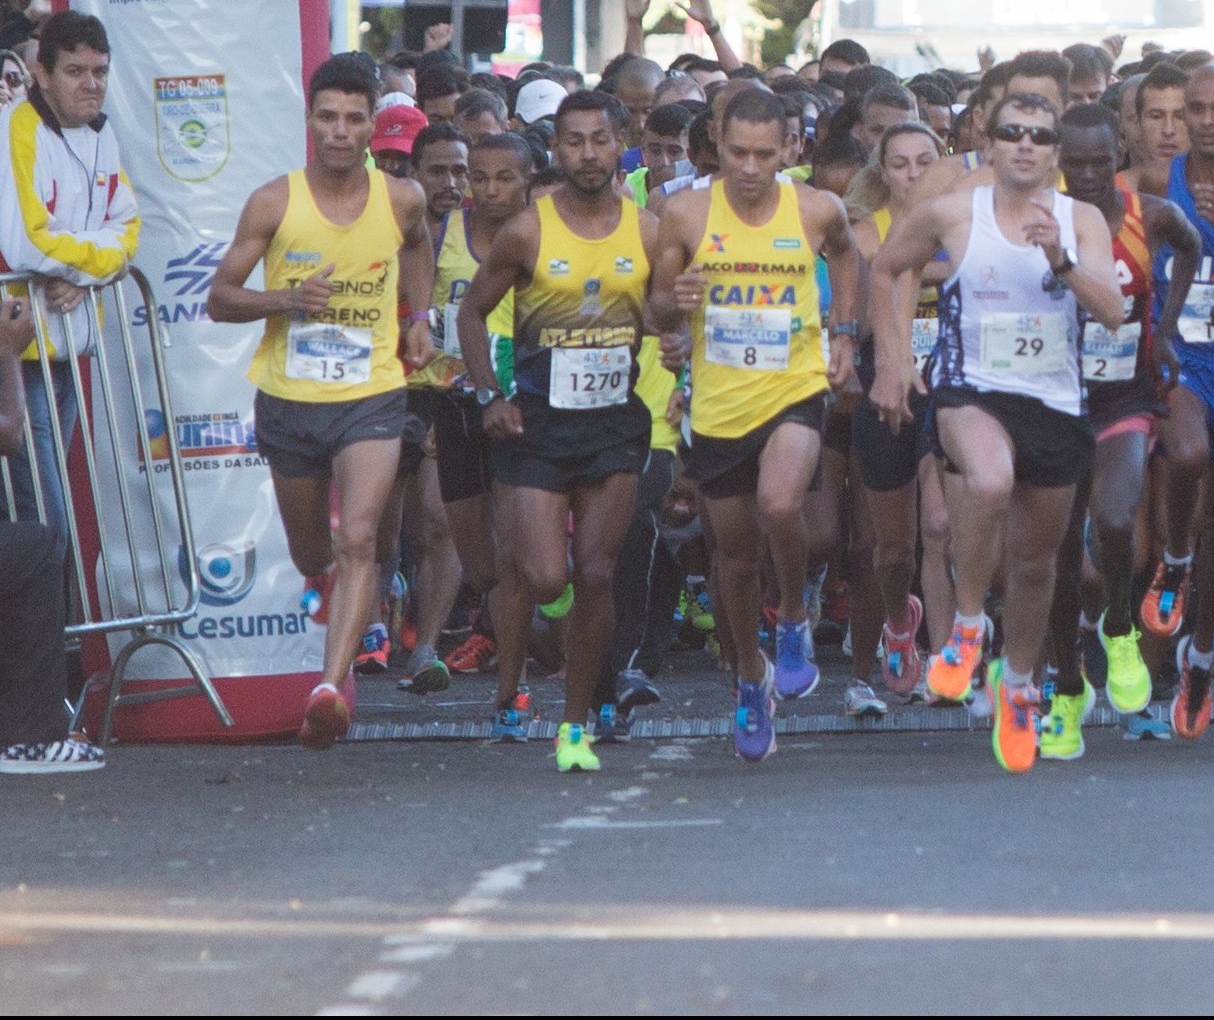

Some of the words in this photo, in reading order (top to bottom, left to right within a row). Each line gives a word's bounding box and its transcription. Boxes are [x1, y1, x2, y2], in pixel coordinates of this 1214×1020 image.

[709, 283, 797, 306] CAIXA
[744, 346, 757, 366] 8
[1014, 338, 1044, 357] 29
[320, 360, 346, 380] 15
[1092, 358, 1108, 378] 2
[570, 370, 621, 393] 1270
[139, 457, 220, 474] POFSÕES
[224, 456, 242, 469] DA
